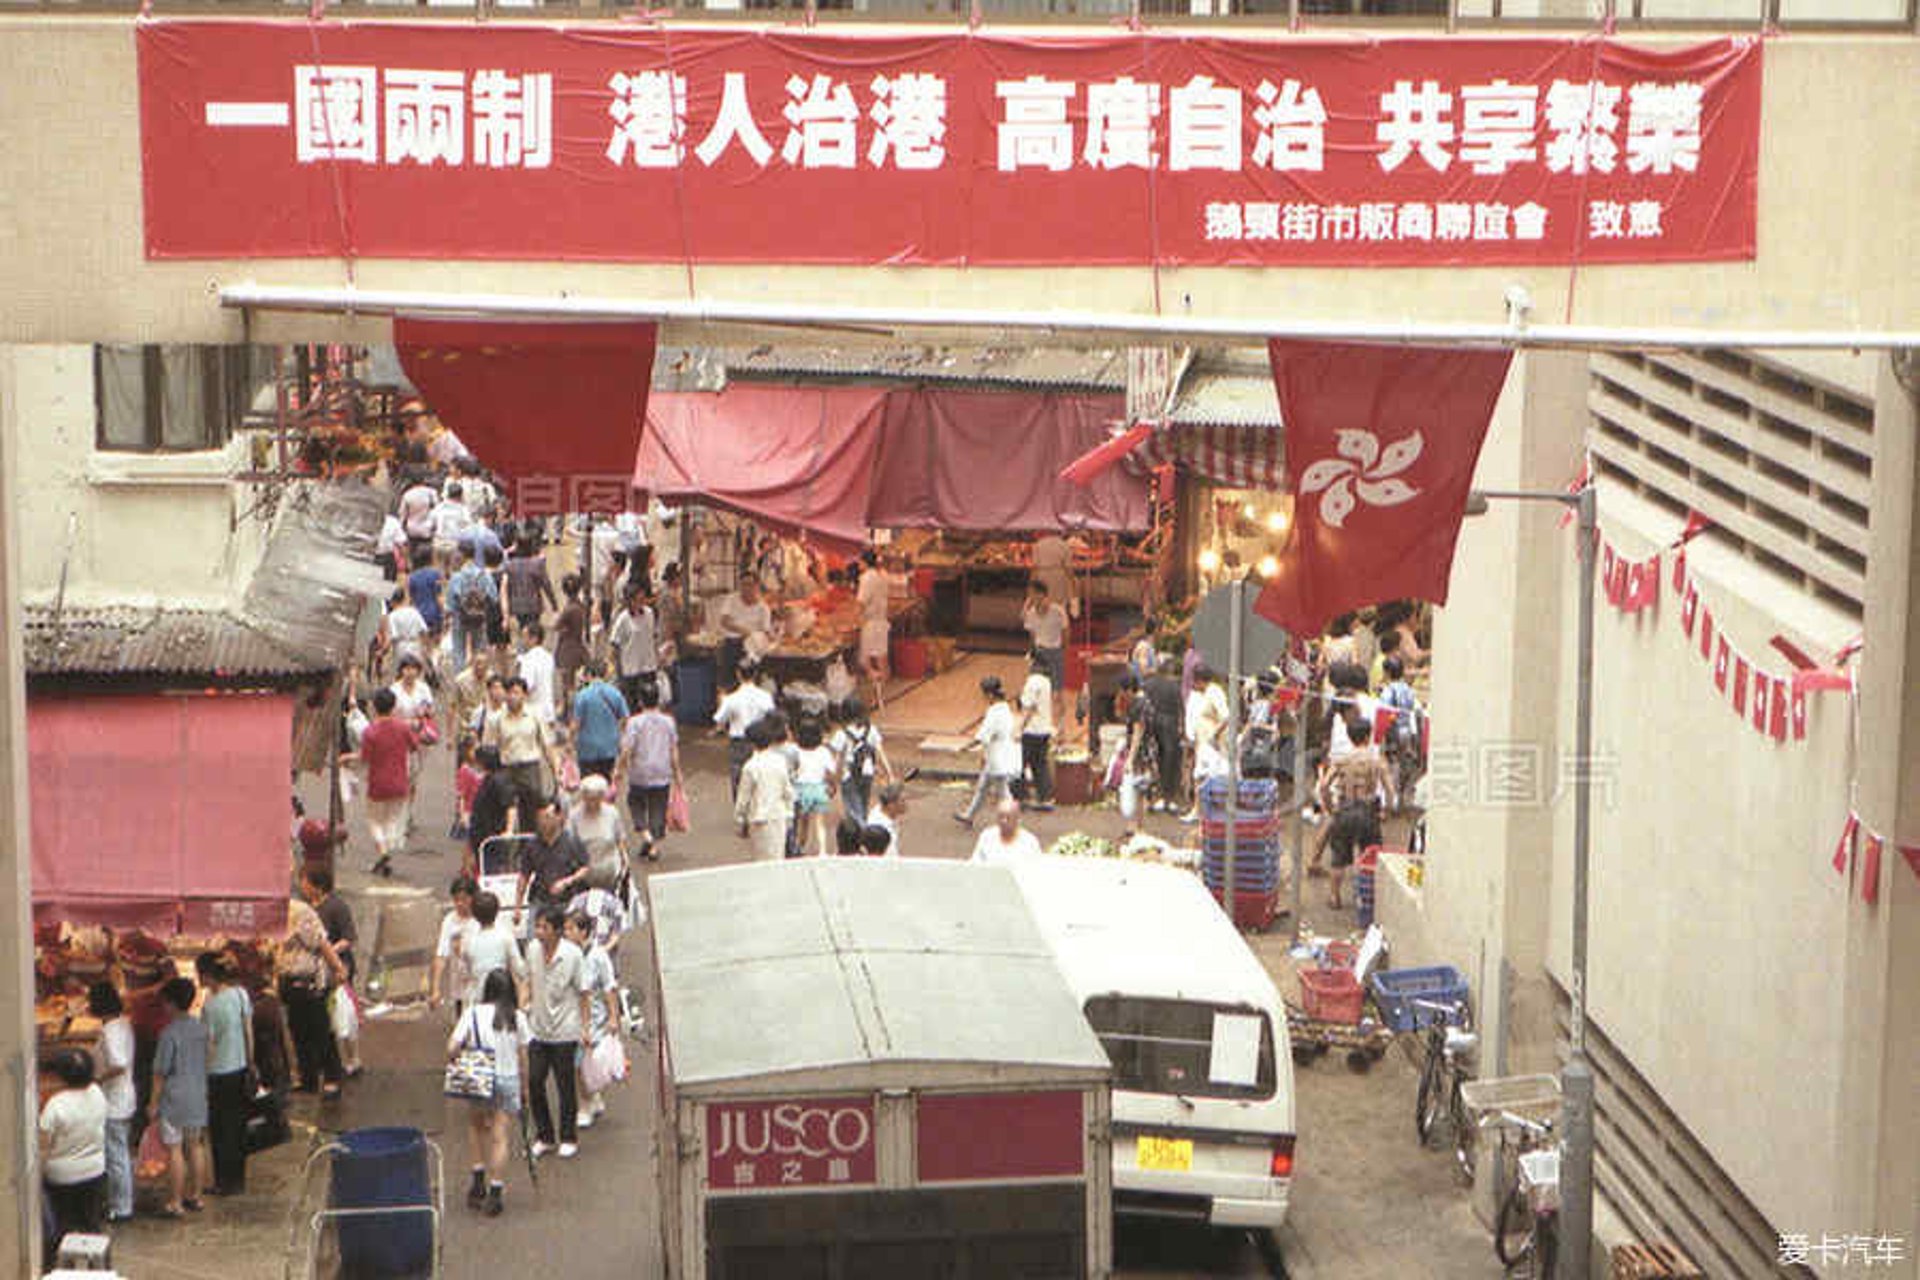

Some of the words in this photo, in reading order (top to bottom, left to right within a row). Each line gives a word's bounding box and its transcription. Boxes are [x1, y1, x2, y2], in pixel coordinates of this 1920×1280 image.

[205, 65, 553, 169] 一國兩制
[605, 70, 947, 168] 港人治港
[995, 75, 1329, 172] 高度自治
[1376, 79, 1703, 176] 共享繁榮
[712, 1103, 870, 1158] JUSCO
